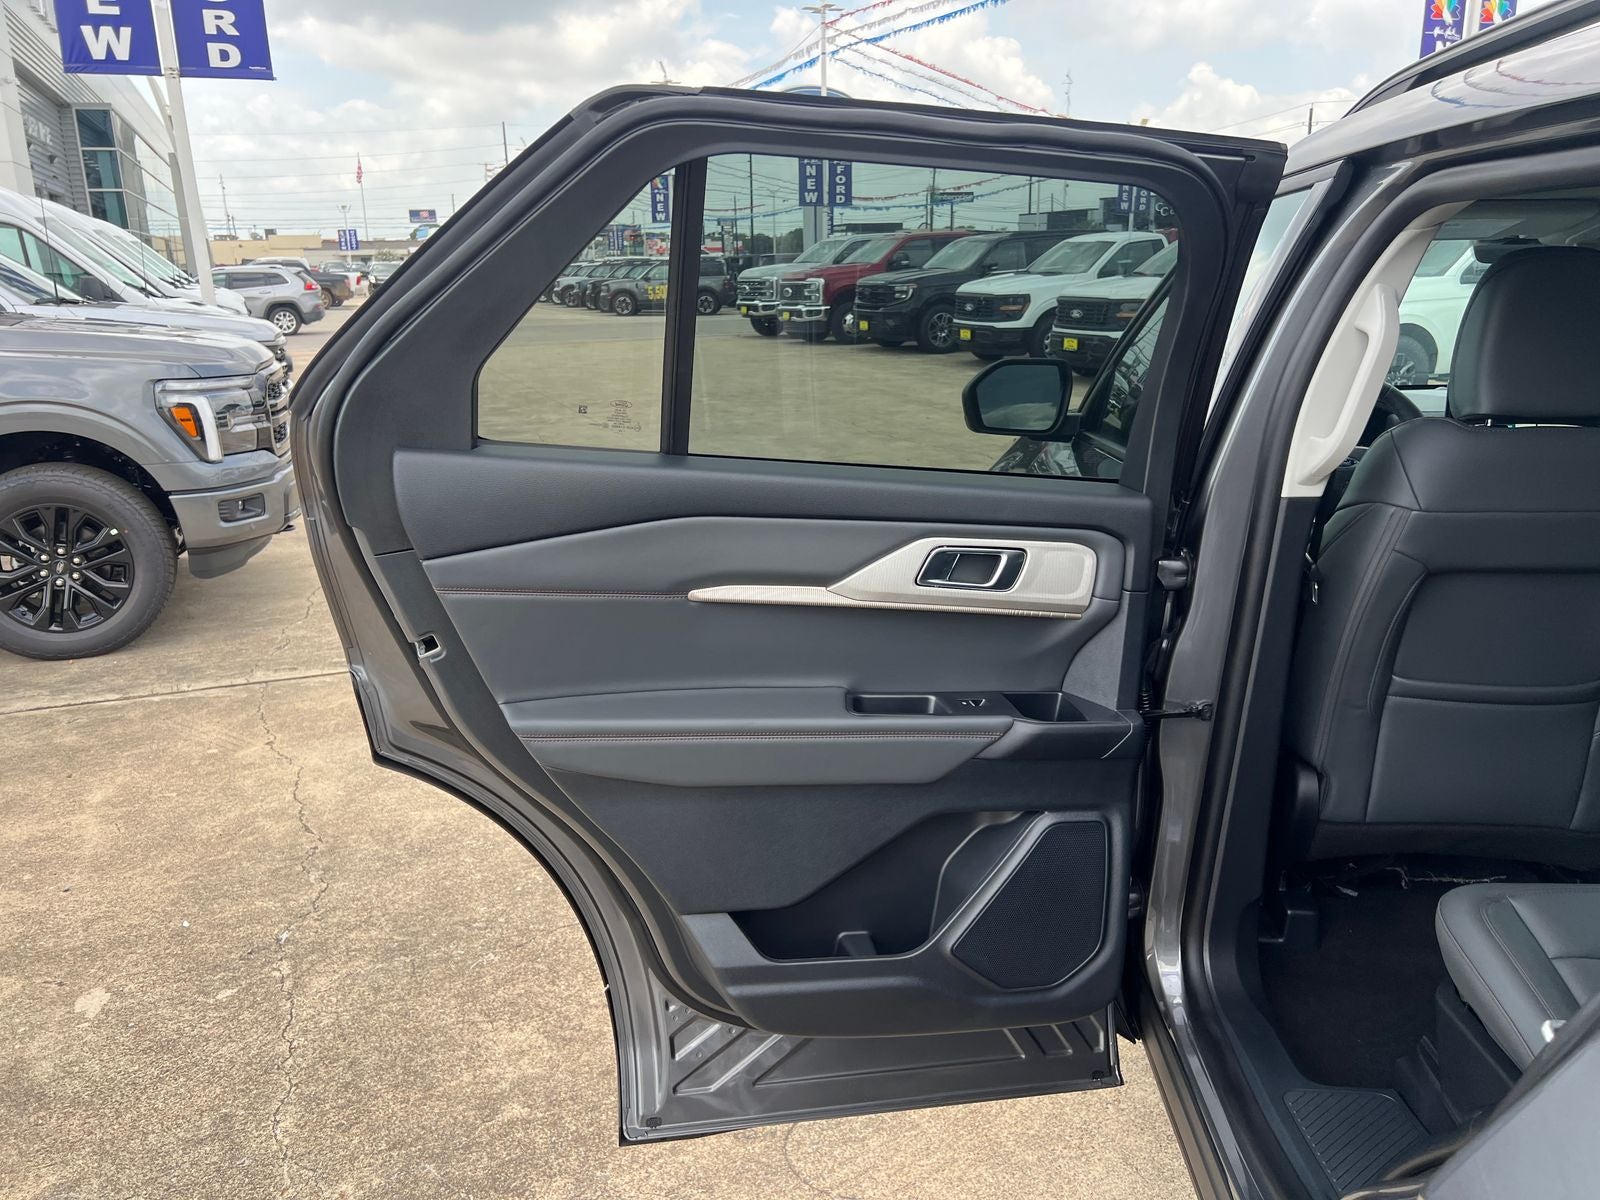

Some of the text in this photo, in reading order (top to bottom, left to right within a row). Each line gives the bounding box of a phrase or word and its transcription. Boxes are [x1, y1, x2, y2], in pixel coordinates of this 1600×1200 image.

[202, 0, 241, 68] RD
[804, 165, 818, 203] NEW
[835, 165, 846, 203] FORD
[655, 193, 666, 221] NEW
